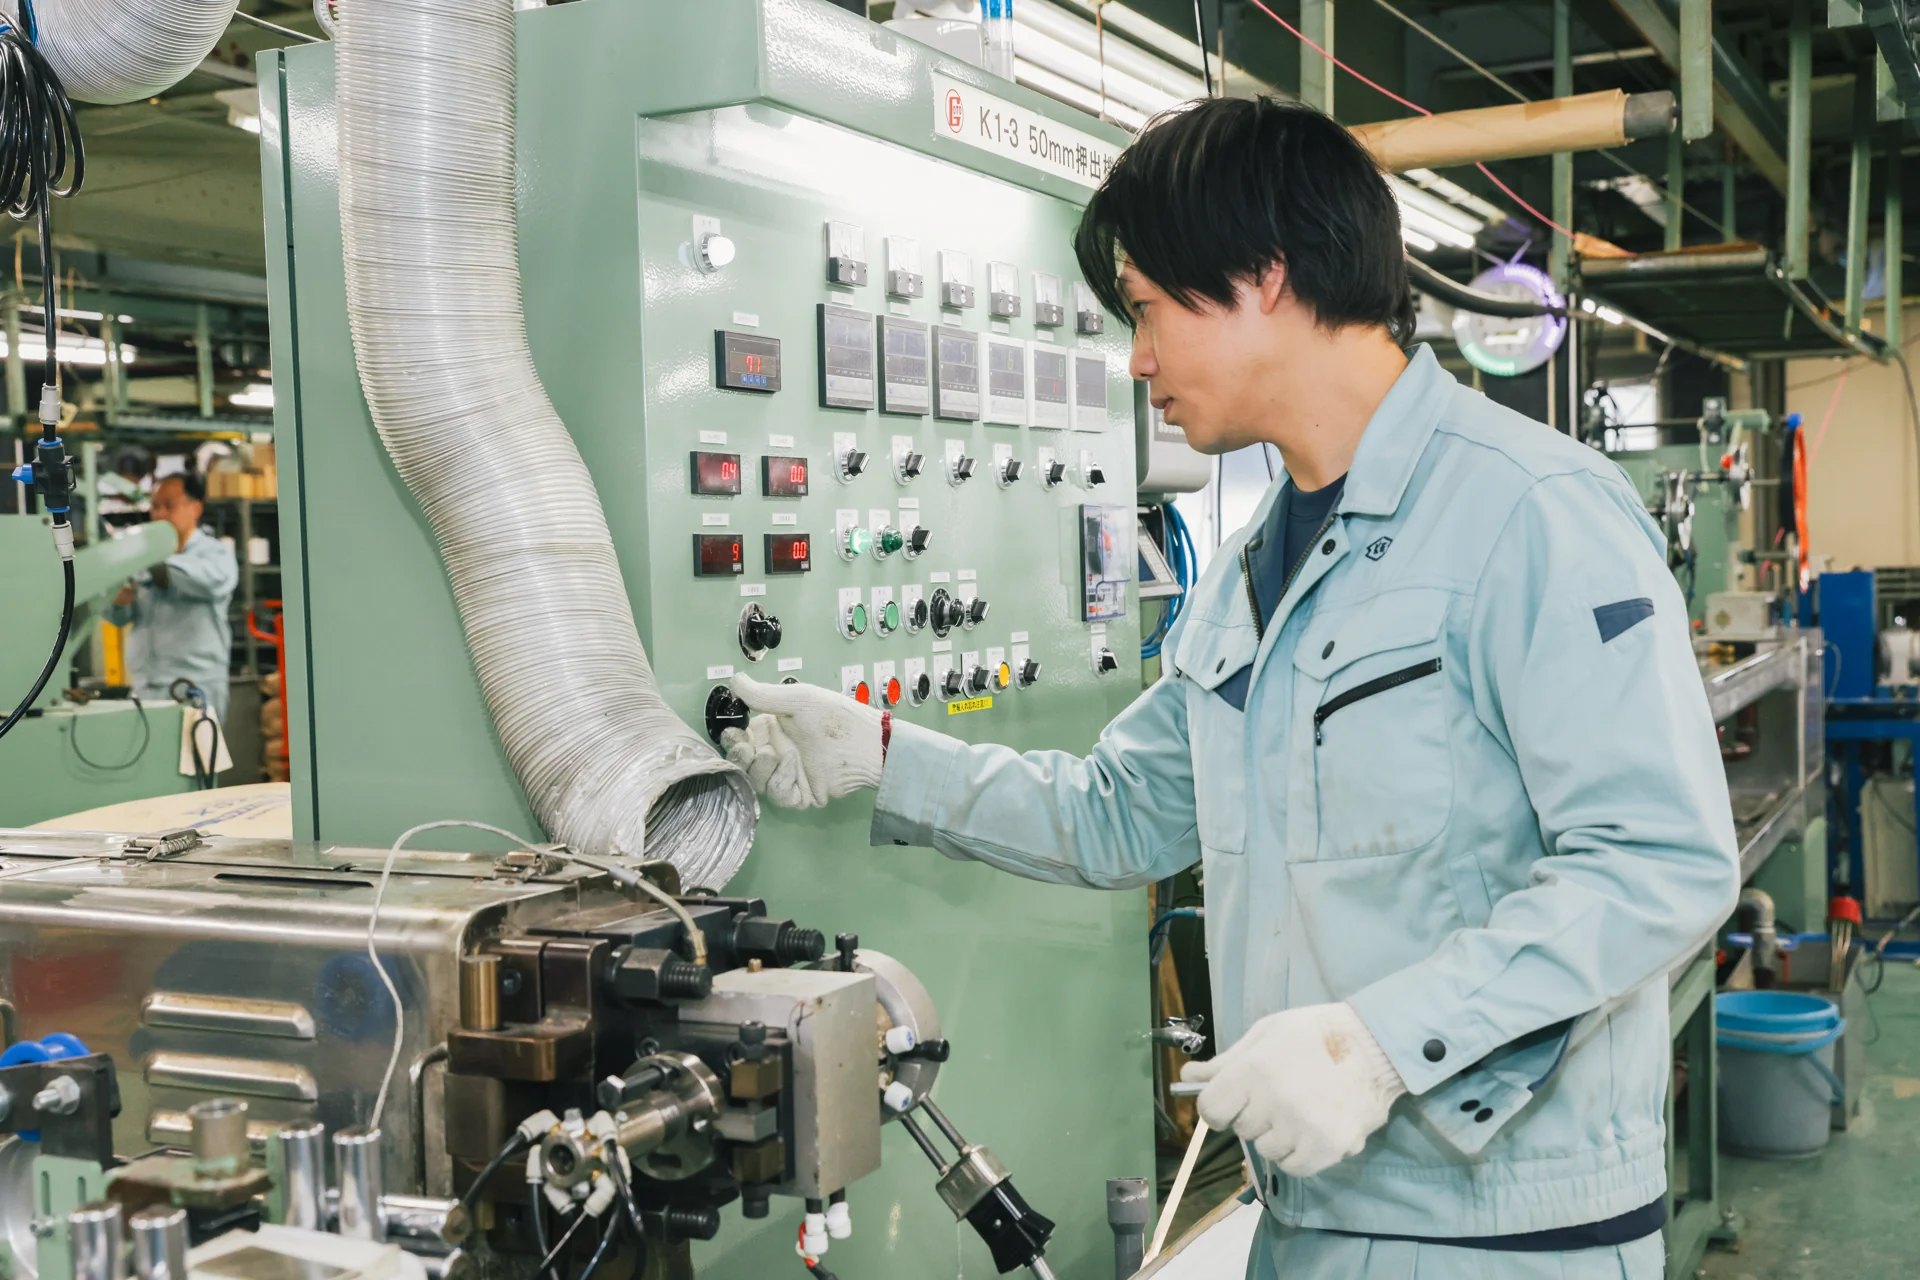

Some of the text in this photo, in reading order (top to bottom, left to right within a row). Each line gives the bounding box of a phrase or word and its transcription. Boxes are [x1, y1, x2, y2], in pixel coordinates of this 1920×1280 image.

[979, 105, 1020, 149] K1-3
[746, 354, 761, 373] 71
[721, 461, 737, 480] 0.4
[790, 465, 805, 483] 0.0
[731, 543, 740, 561] 9
[792, 541, 807, 559] 0.0
